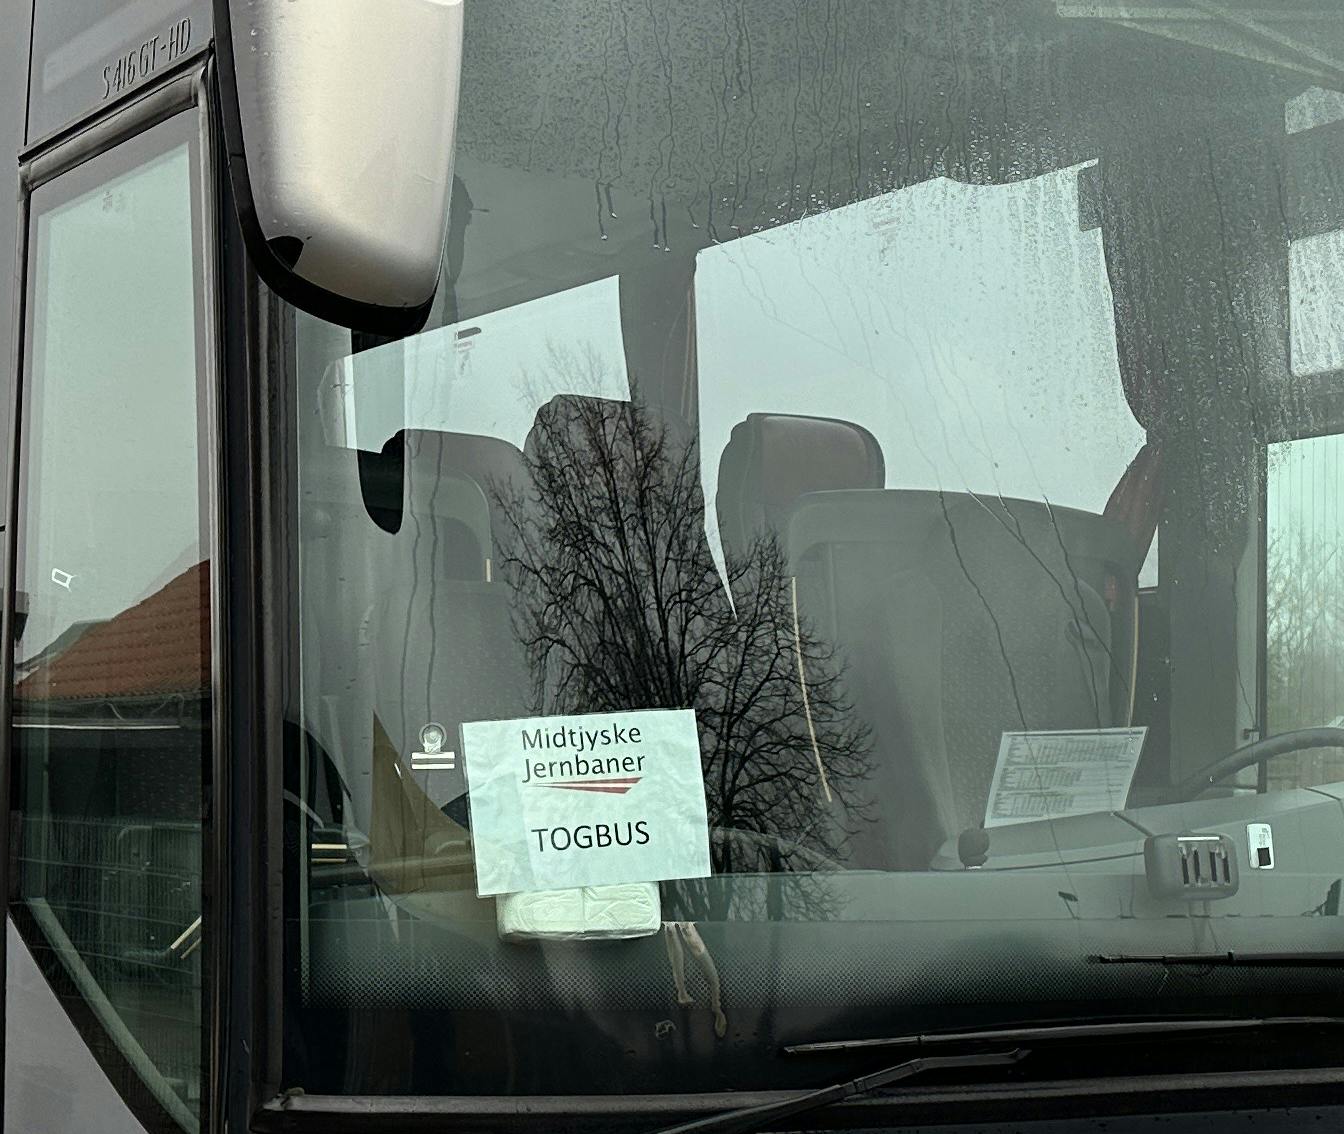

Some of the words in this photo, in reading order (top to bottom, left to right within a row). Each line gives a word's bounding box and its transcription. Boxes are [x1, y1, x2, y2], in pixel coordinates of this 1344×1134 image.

[102, 66, 111, 100] S
[113, 50, 136, 92] 416
[139, 17, 191, 78] GT-HD
[521, 722, 643, 752] Midtjyske
[521, 754, 646, 784] Jernbaner
[531, 820, 651, 853] TOGBUS
